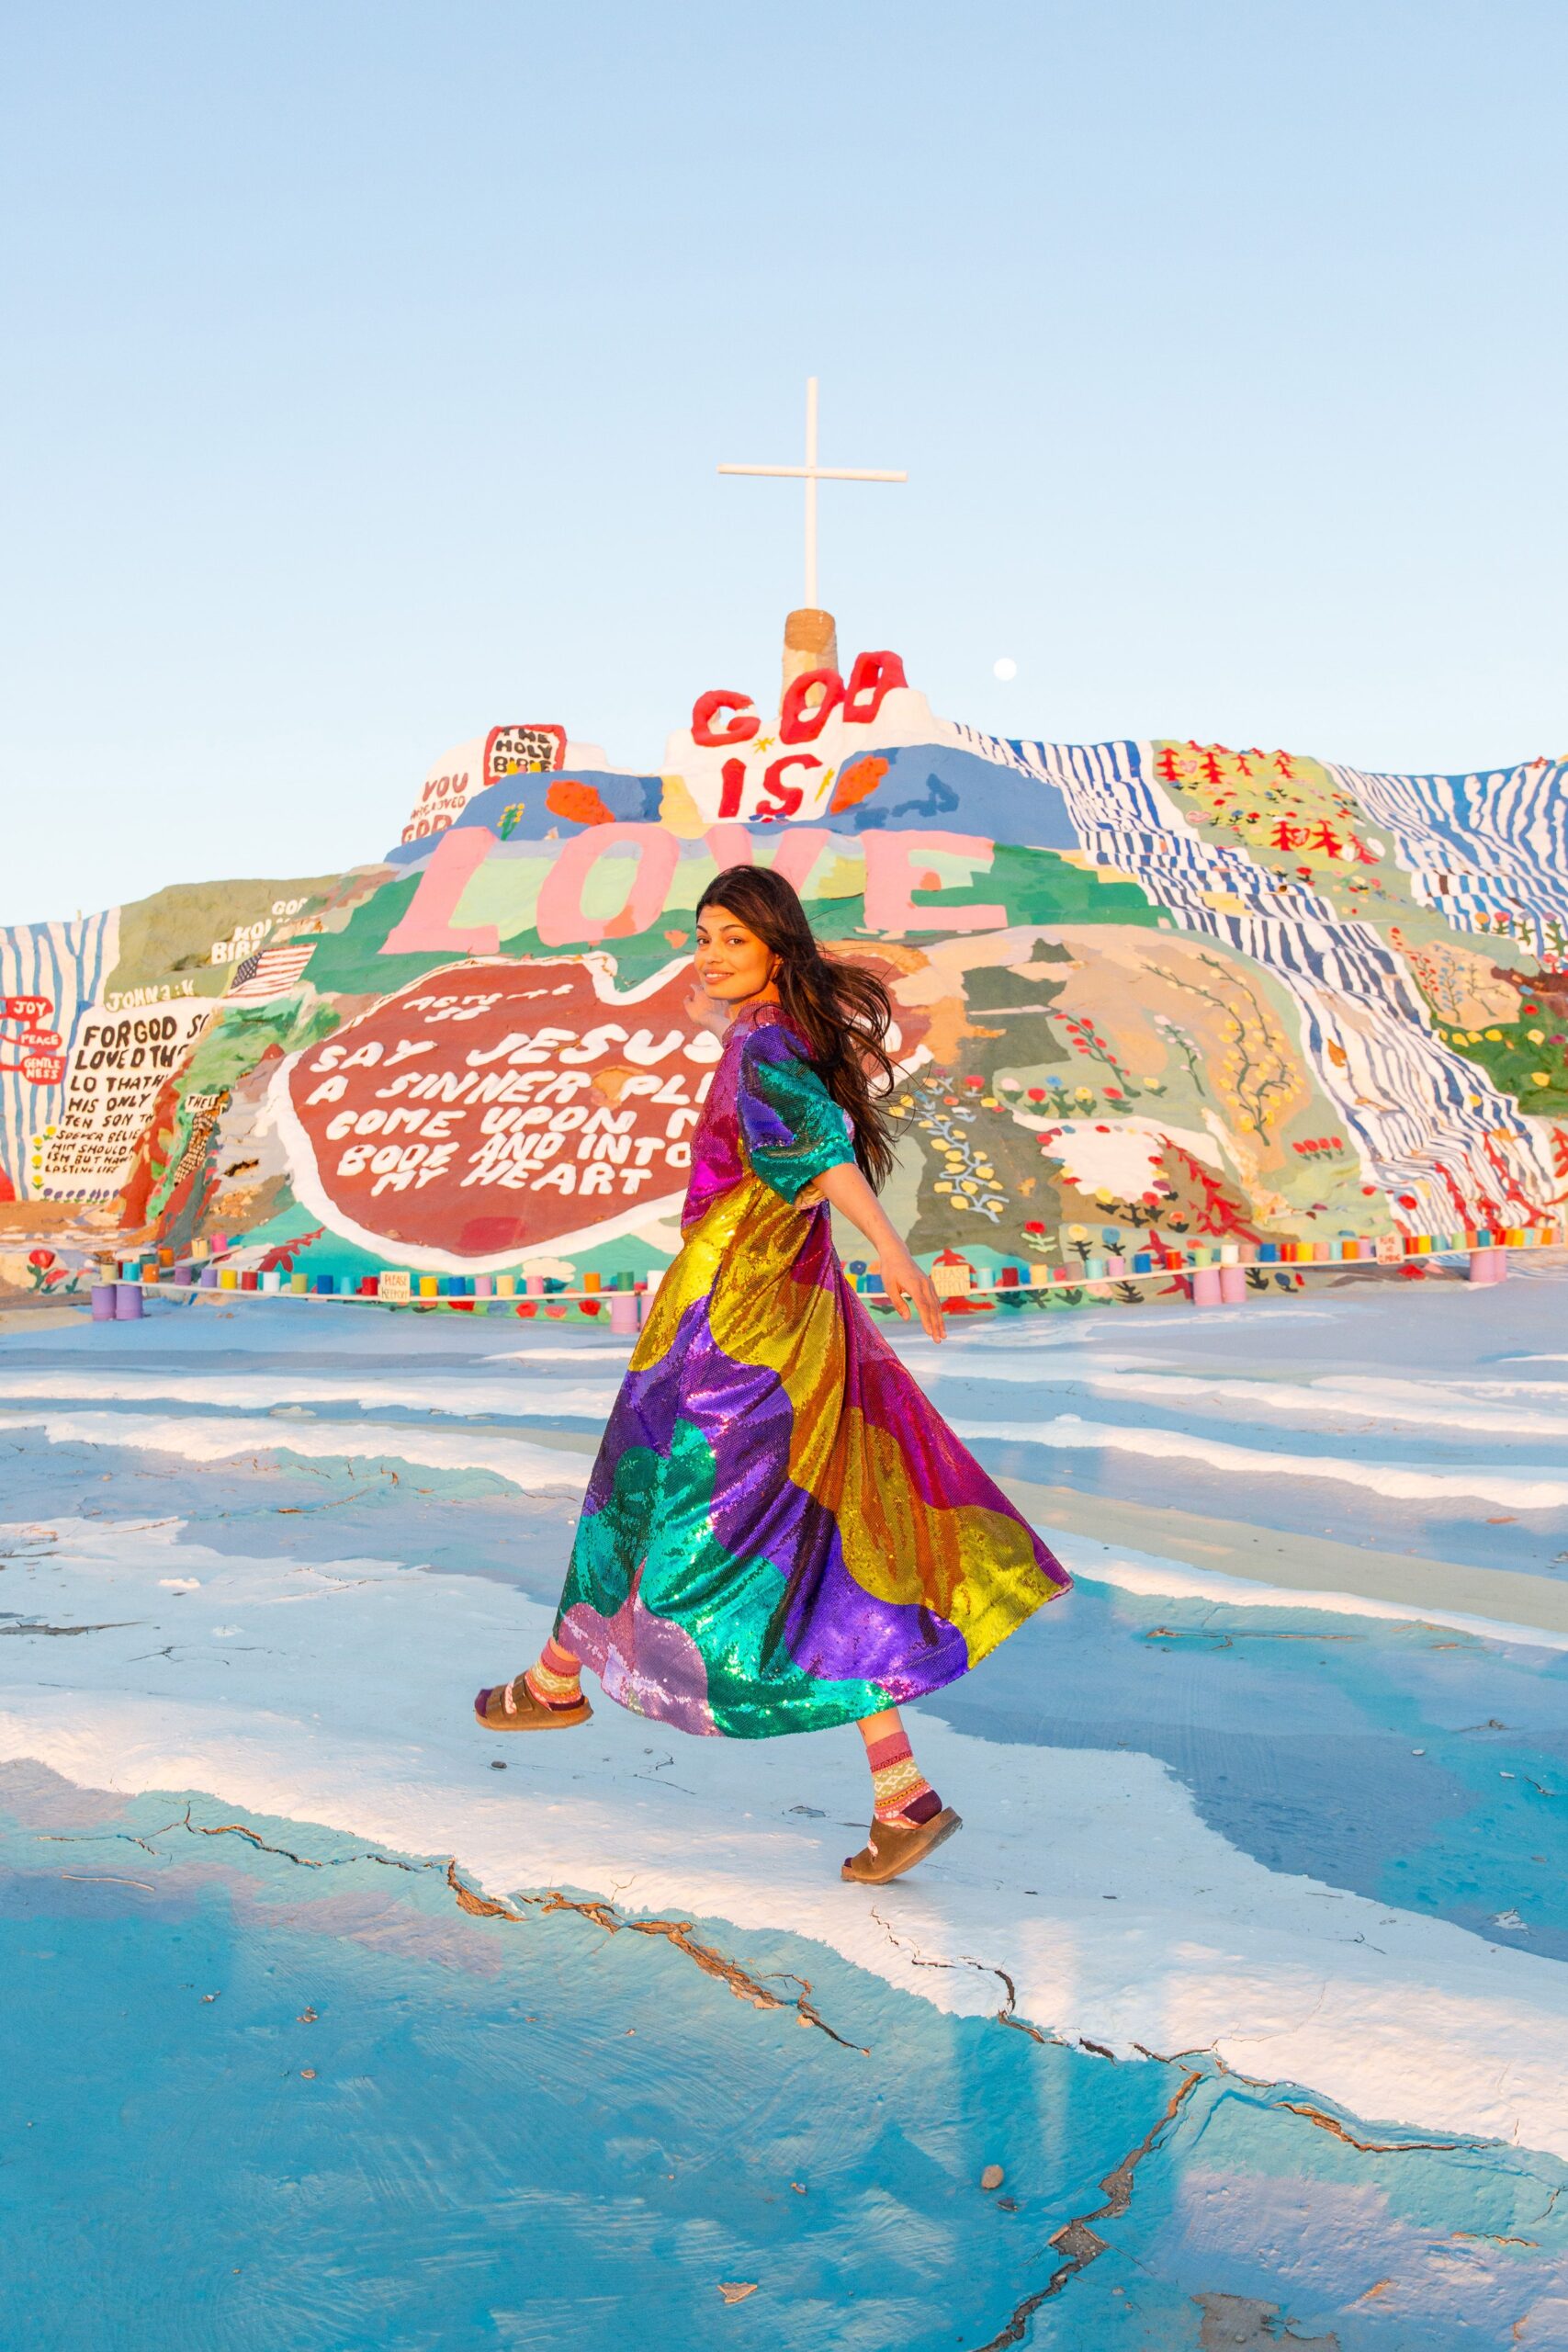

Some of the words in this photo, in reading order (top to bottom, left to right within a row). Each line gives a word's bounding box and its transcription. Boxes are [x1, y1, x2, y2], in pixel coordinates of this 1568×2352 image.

[692, 650, 908, 747] GOD
[495, 740, 553, 760] HOLY
[422, 772, 468, 802] YOU
[718, 753, 823, 818] IS
[14, 1001, 46, 1016] JOY
[106, 985, 158, 1011] JOHN
[20, 1033, 59, 1046] PEACE
[84, 1020, 131, 1048] FOR
[134, 1016, 177, 1044] GOD
[74, 1047, 145, 1069] LOVED
[310, 1039, 438, 1072] SAY
[466, 1023, 724, 1067] JESUS
[24, 1057, 61, 1069] GENTLE
[26, 1069, 59, 1080] NESS
[304, 1075, 349, 1105] A
[375, 1069, 592, 1104] SINNER
[68, 1097, 99, 1114] HIS
[107, 1092, 152, 1111] ONLY
[65, 1114, 93, 1129] TEN
[102, 1114, 133, 1127] SON
[326, 1107, 467, 1140] COME
[480, 1105, 637, 1134] UPON
[78, 1144, 127, 1156] SHOULD
[468, 1131, 566, 1163] AND
[577, 1132, 691, 1168] INTO
[370, 1166, 448, 1196] MY
[459, 1159, 653, 1195] HEART
